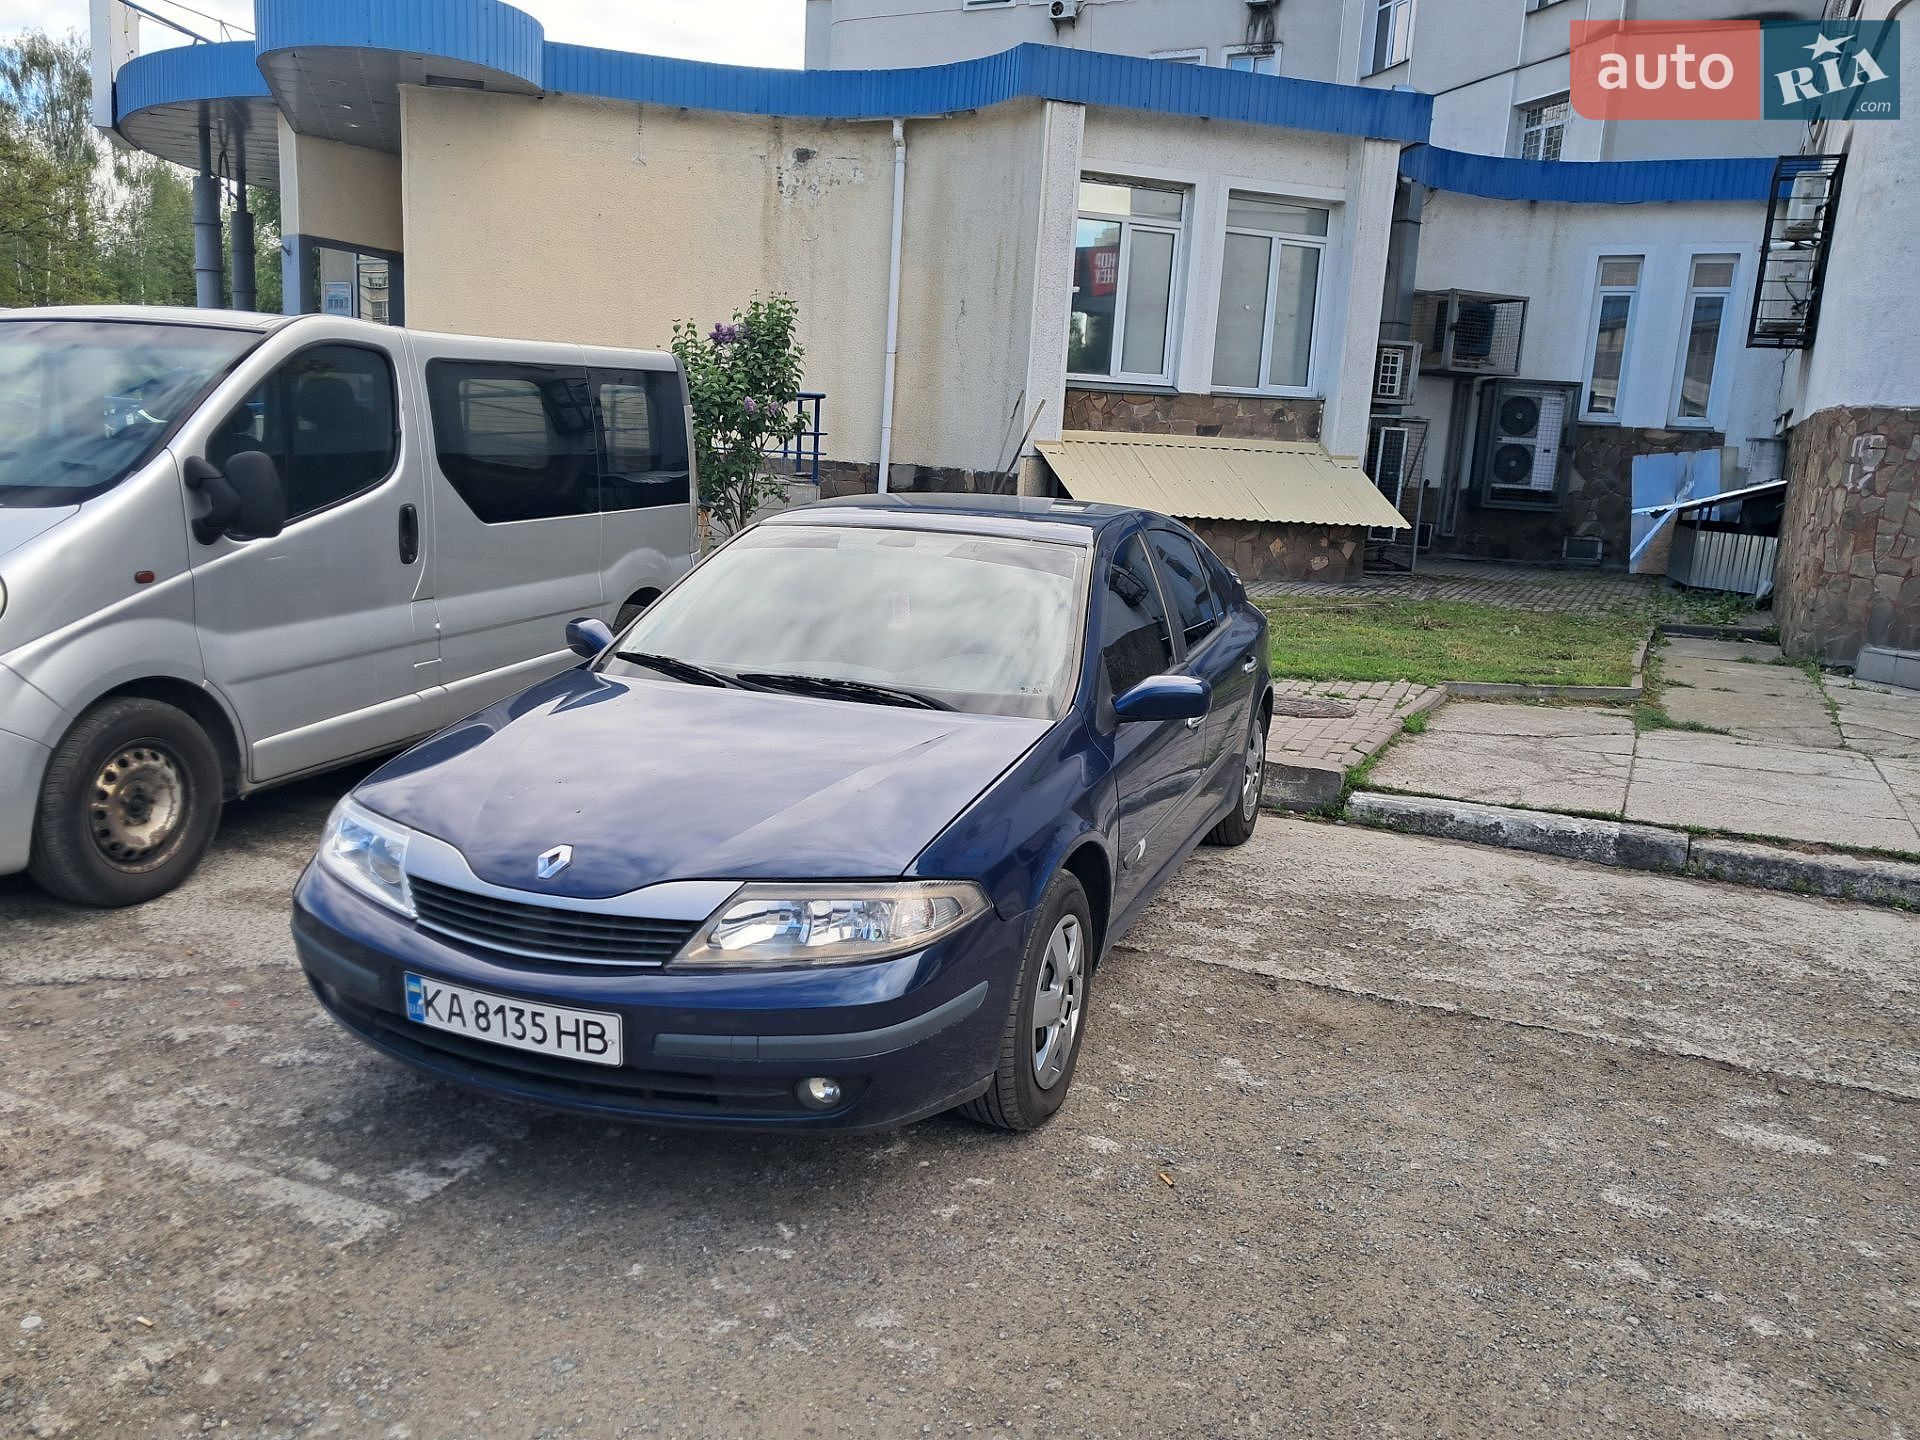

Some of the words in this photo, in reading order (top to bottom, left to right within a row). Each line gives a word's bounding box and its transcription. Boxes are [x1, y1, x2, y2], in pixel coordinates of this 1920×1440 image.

[423, 985, 467, 1027] KA
[473, 1000, 548, 1045] 8135
[556, 1015, 609, 1055] HB
